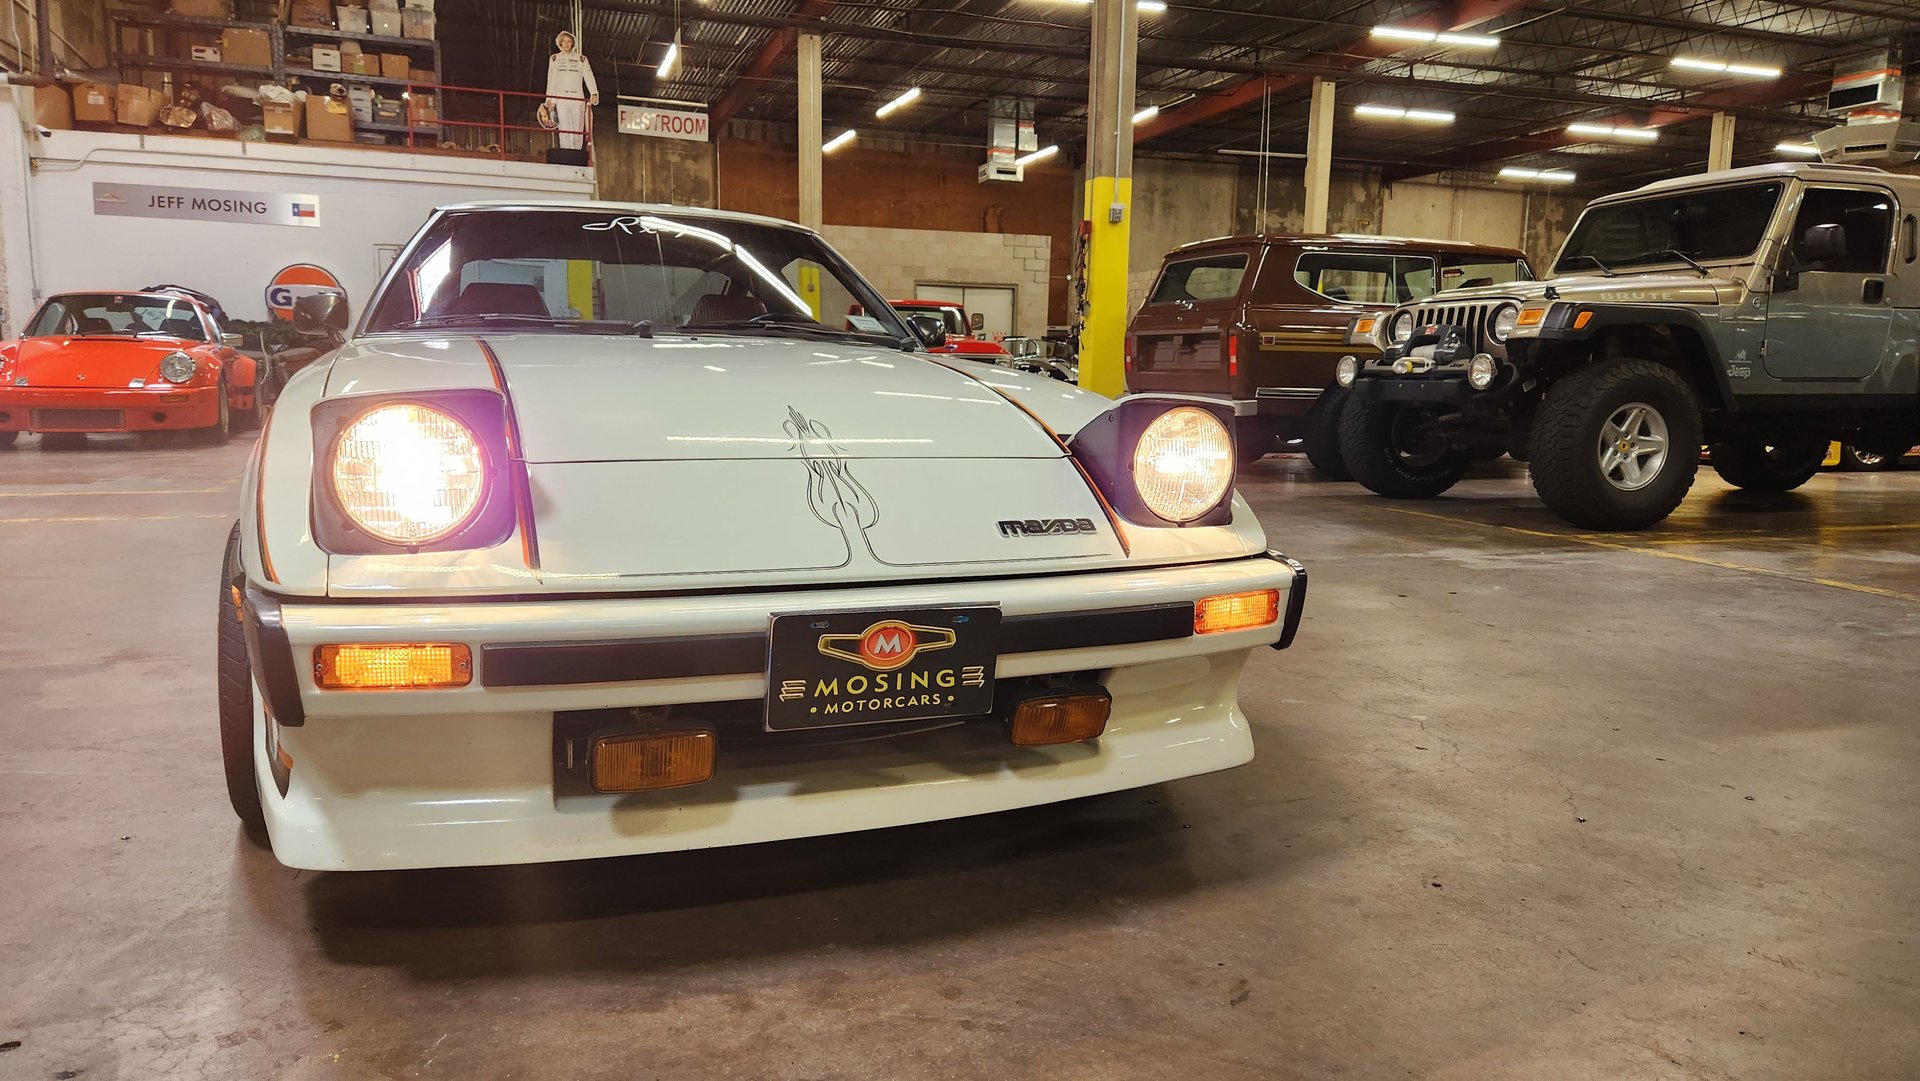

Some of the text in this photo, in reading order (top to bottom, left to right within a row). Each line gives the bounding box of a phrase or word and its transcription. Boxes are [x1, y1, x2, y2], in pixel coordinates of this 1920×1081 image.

[148, 195, 268, 214] JEFF MOSING
[1601, 292, 1674, 301] BRUTE
[1727, 364, 1751, 379] Jeep
[873, 633, 902, 654] M
[814, 669, 956, 698] MOSING
[824, 692, 941, 715] MOTORCARS
